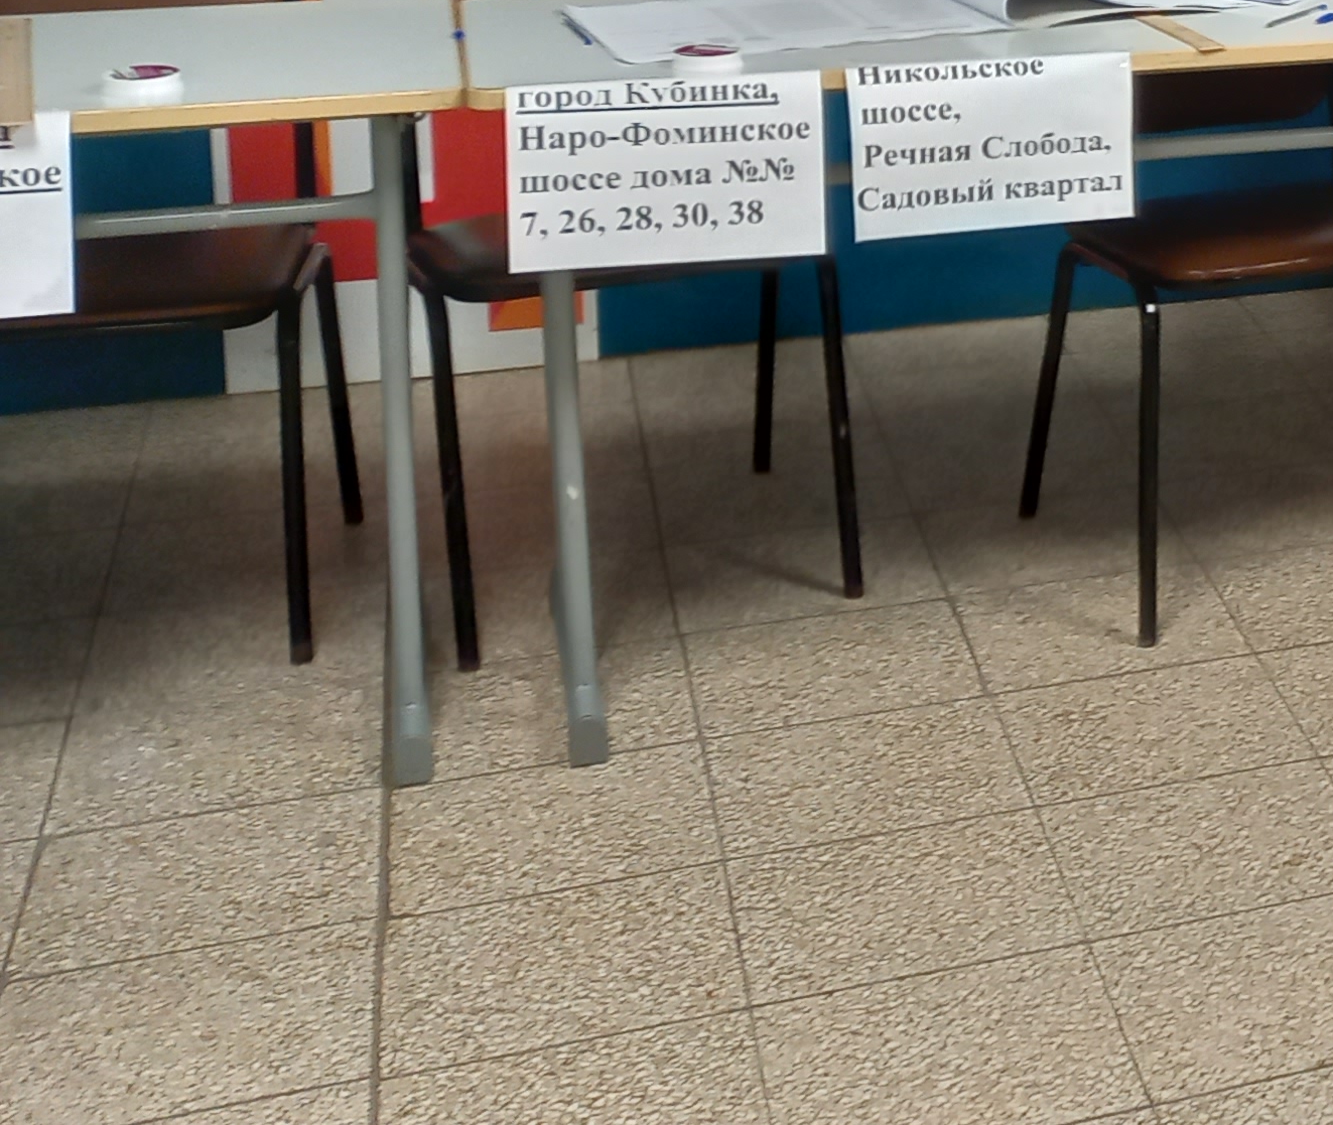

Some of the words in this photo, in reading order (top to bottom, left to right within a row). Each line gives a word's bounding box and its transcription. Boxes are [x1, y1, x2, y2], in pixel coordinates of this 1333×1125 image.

[858, 58, 1044, 86] Никольское
[517, 89, 613, 111] город
[626, 80, 780, 106] Кубинка,
[861, 101, 961, 125] шоссе,
[518, 121, 811, 156] Наро-Фоминское
[864, 143, 972, 169] Речная
[981, 132, 1112, 161] Слобода,
[519, 171, 623, 194] шоссе
[630, 167, 712, 190] дома
[722, 157, 795, 183] №№
[857, 178, 994, 211] Садовый
[1005, 174, 1123, 203] квартал
[520, 211, 549, 240] 7,
[558, 208, 606, 237] 26,
[616, 205, 663, 233] 28,
[672, 202, 718, 230] 30,
[727, 199, 764, 226] 38
